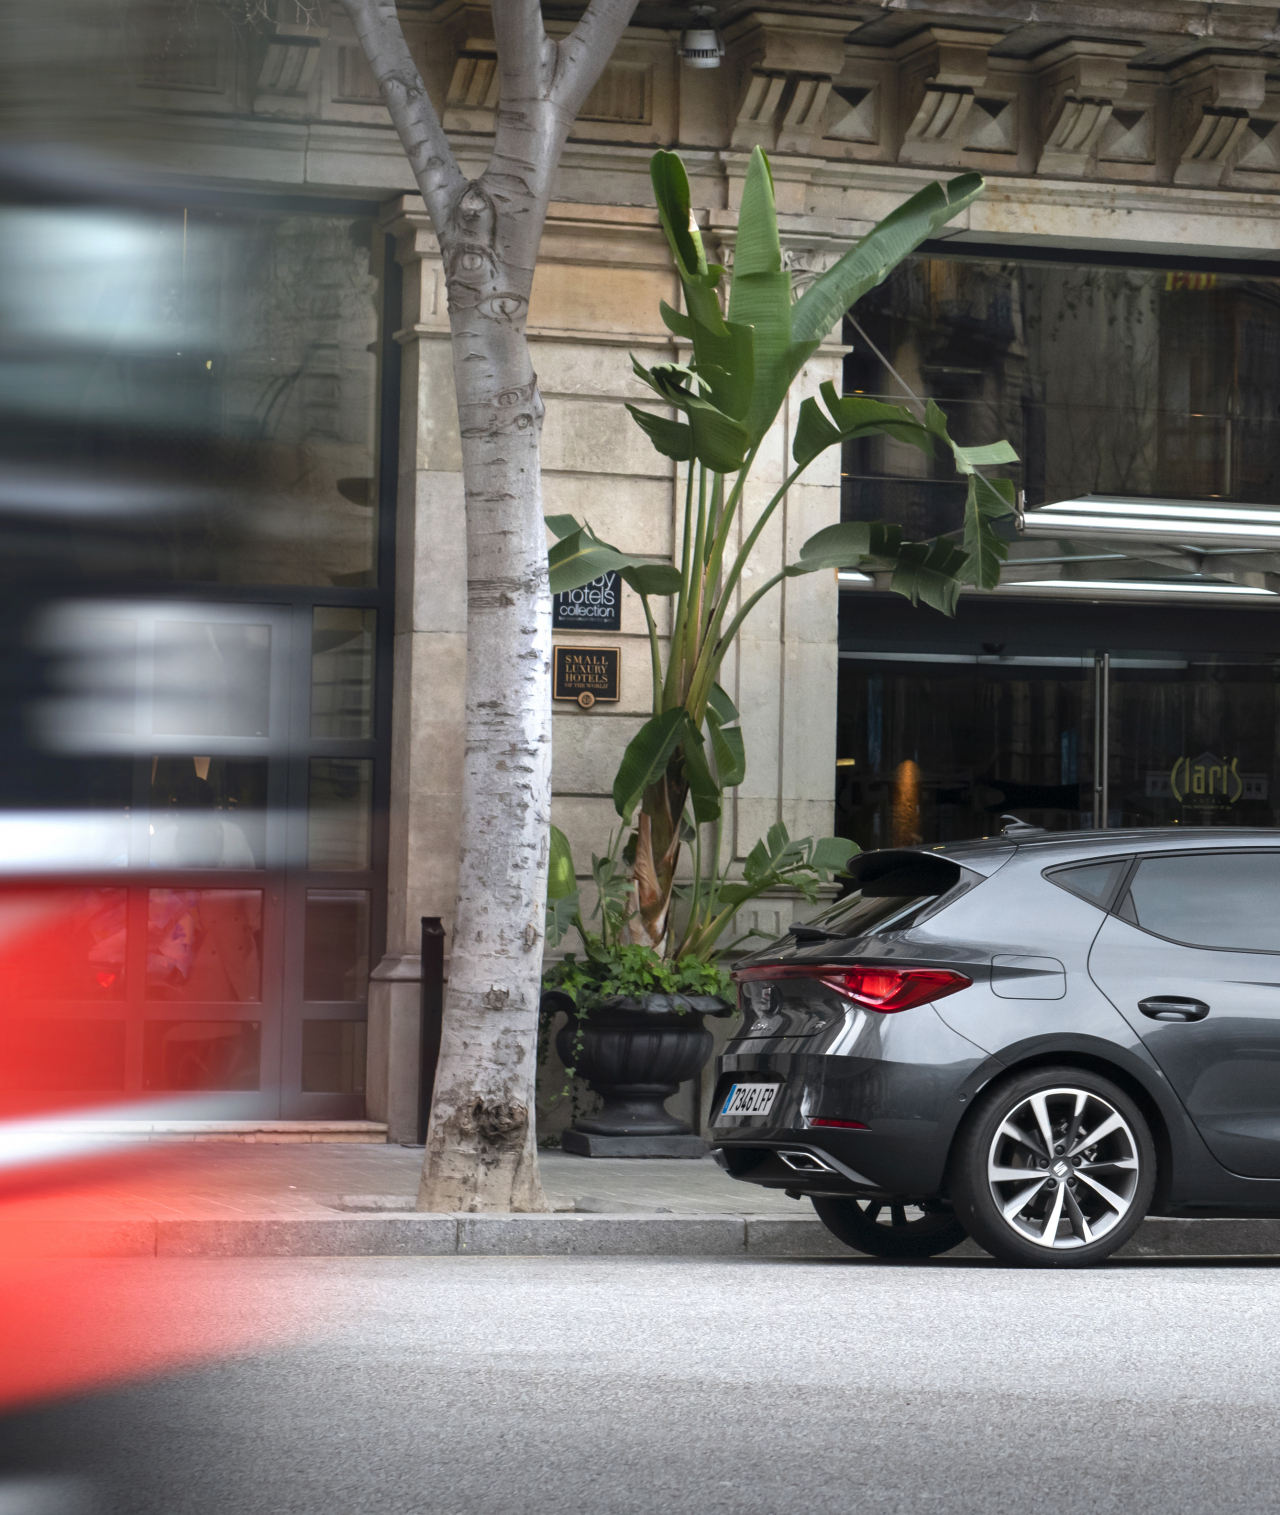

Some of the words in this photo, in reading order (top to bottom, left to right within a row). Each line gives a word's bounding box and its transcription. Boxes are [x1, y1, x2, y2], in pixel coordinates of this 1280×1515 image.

[559, 603, 615, 617] collection
[565, 655, 609, 665] SMALL
[565, 664, 608, 674] LUXURY
[565, 673, 608, 683] HOTELS
